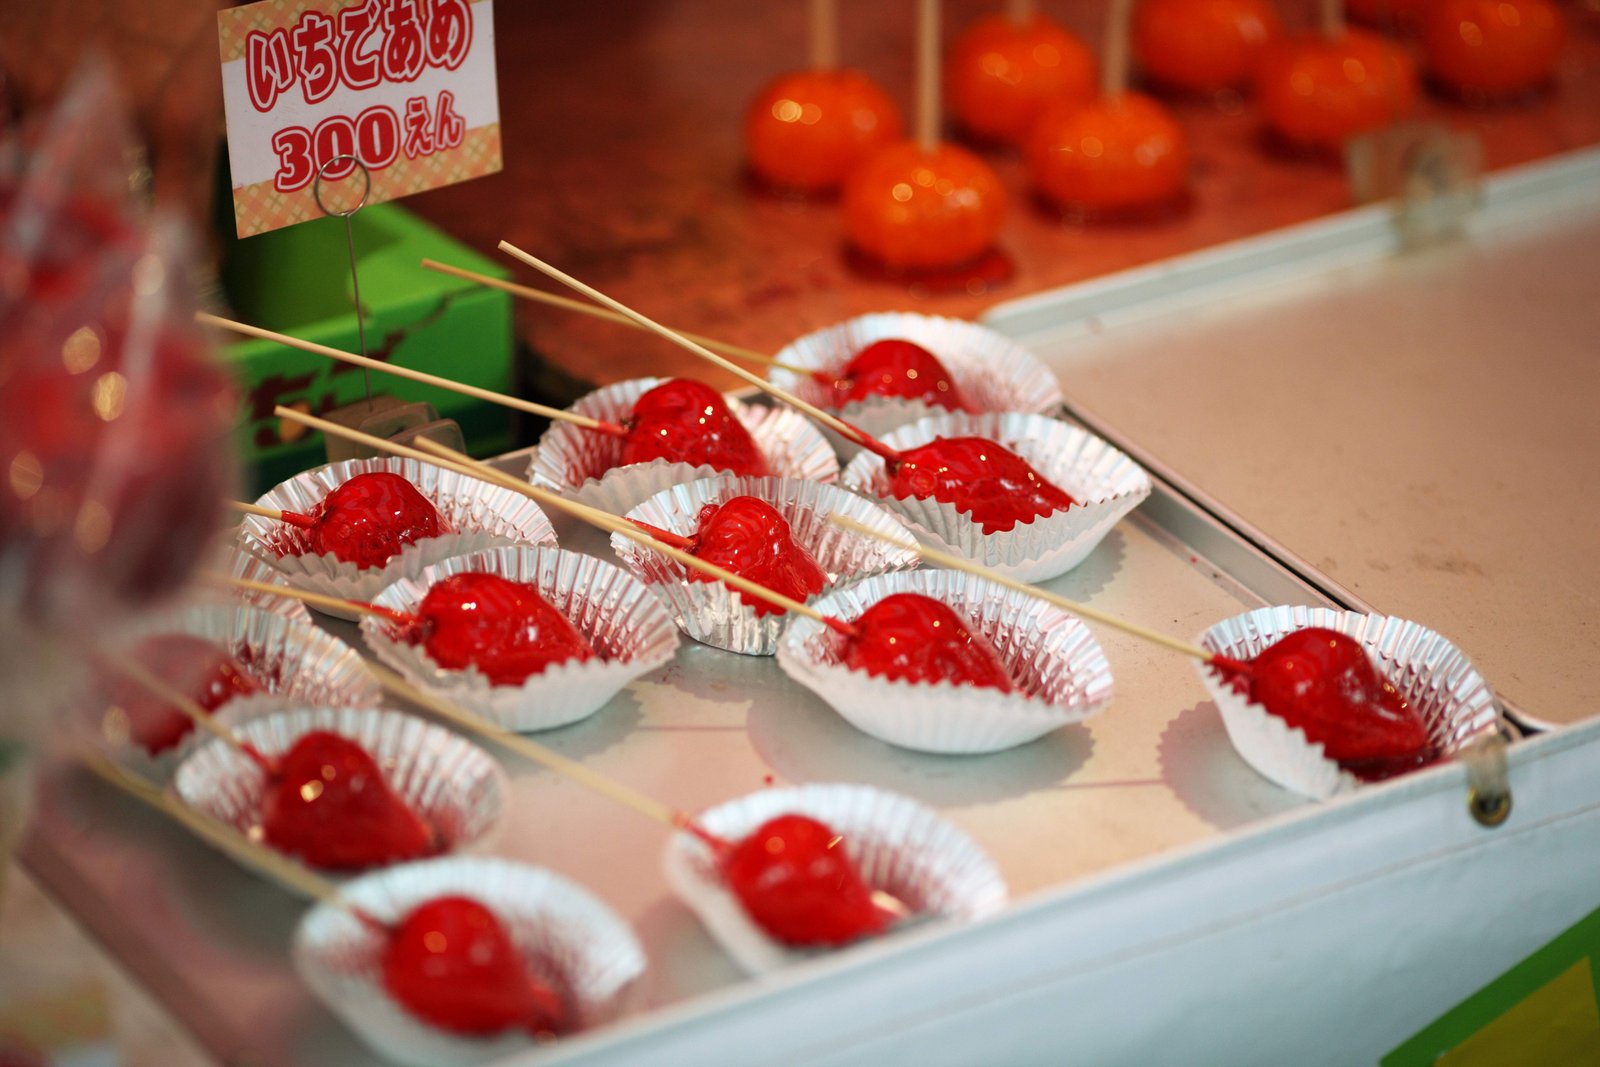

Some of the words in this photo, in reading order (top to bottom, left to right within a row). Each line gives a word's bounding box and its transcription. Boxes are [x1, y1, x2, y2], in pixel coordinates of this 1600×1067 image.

[246, 0, 473, 112] いちごあめ
